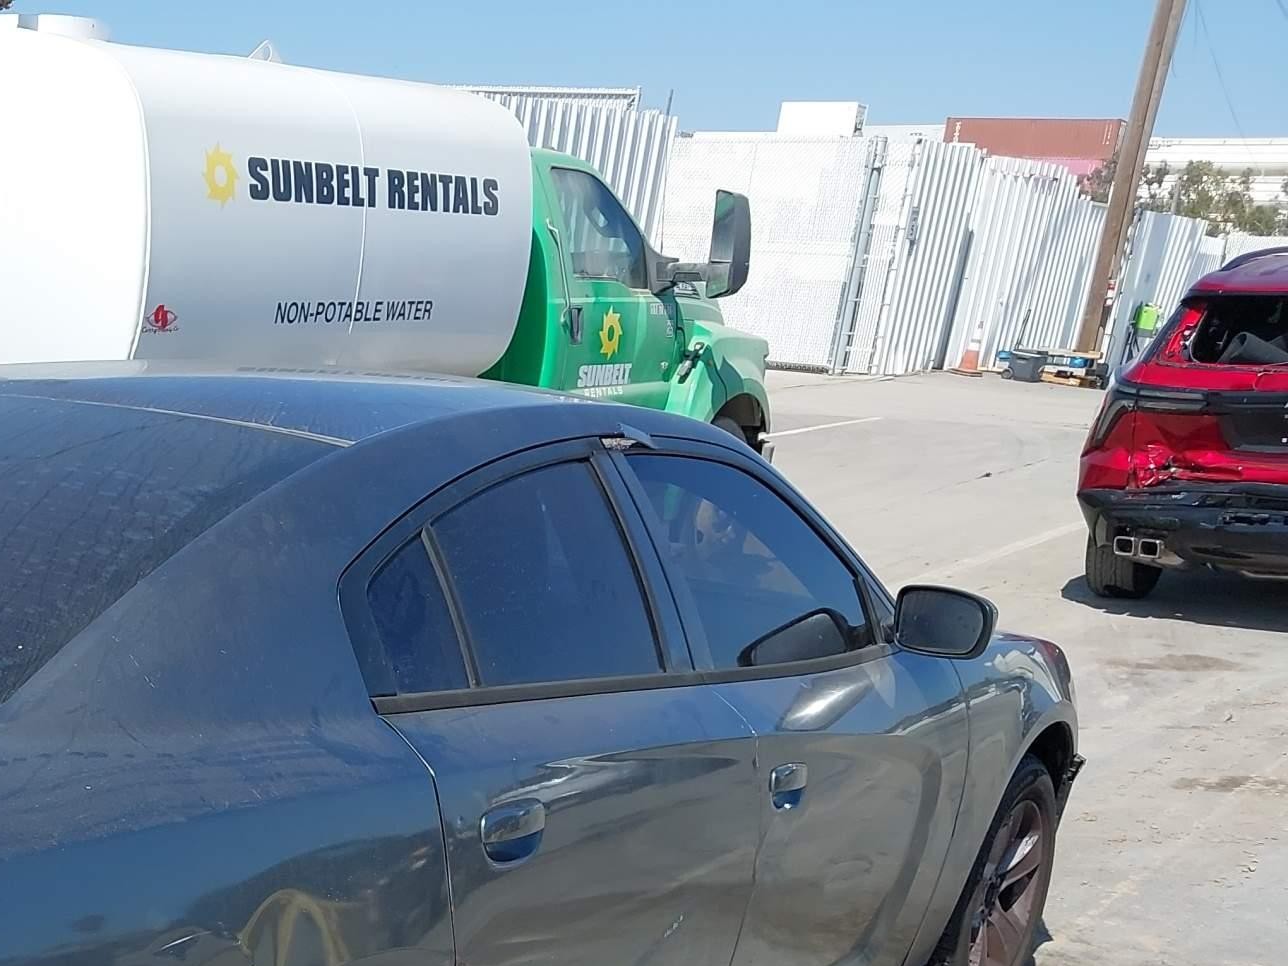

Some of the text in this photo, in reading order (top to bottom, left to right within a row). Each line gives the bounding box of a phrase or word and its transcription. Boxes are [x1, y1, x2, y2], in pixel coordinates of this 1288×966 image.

[247, 156, 499, 216] SUNBELT RENTALS
[274, 300, 433, 324] NON-POTABLE WATER
[577, 363, 632, 388] SUNBELT
[584, 386, 623, 398] RENTALS
